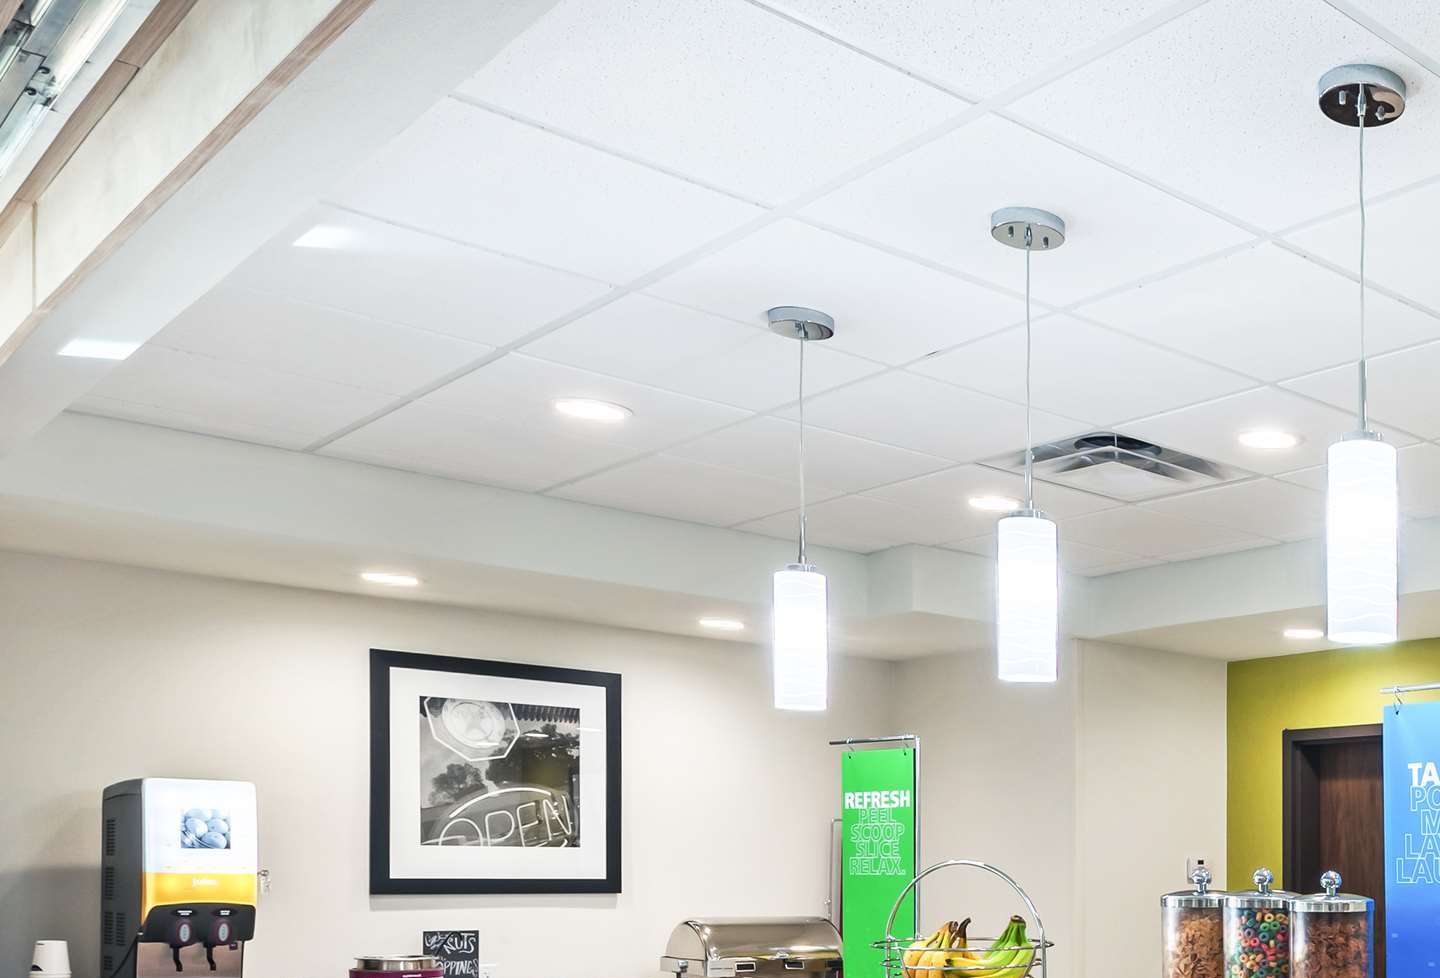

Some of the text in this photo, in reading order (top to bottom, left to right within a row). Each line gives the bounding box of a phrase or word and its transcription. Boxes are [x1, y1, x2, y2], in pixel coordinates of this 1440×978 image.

[844, 789, 911, 809] REFRESH
[438, 796, 572, 847] OPEN
[858, 807, 897, 825] PEEL
[850, 822, 906, 843] SCOOP
[855, 839, 901, 859] SLICE
[848, 856, 907, 877] RELAX.
